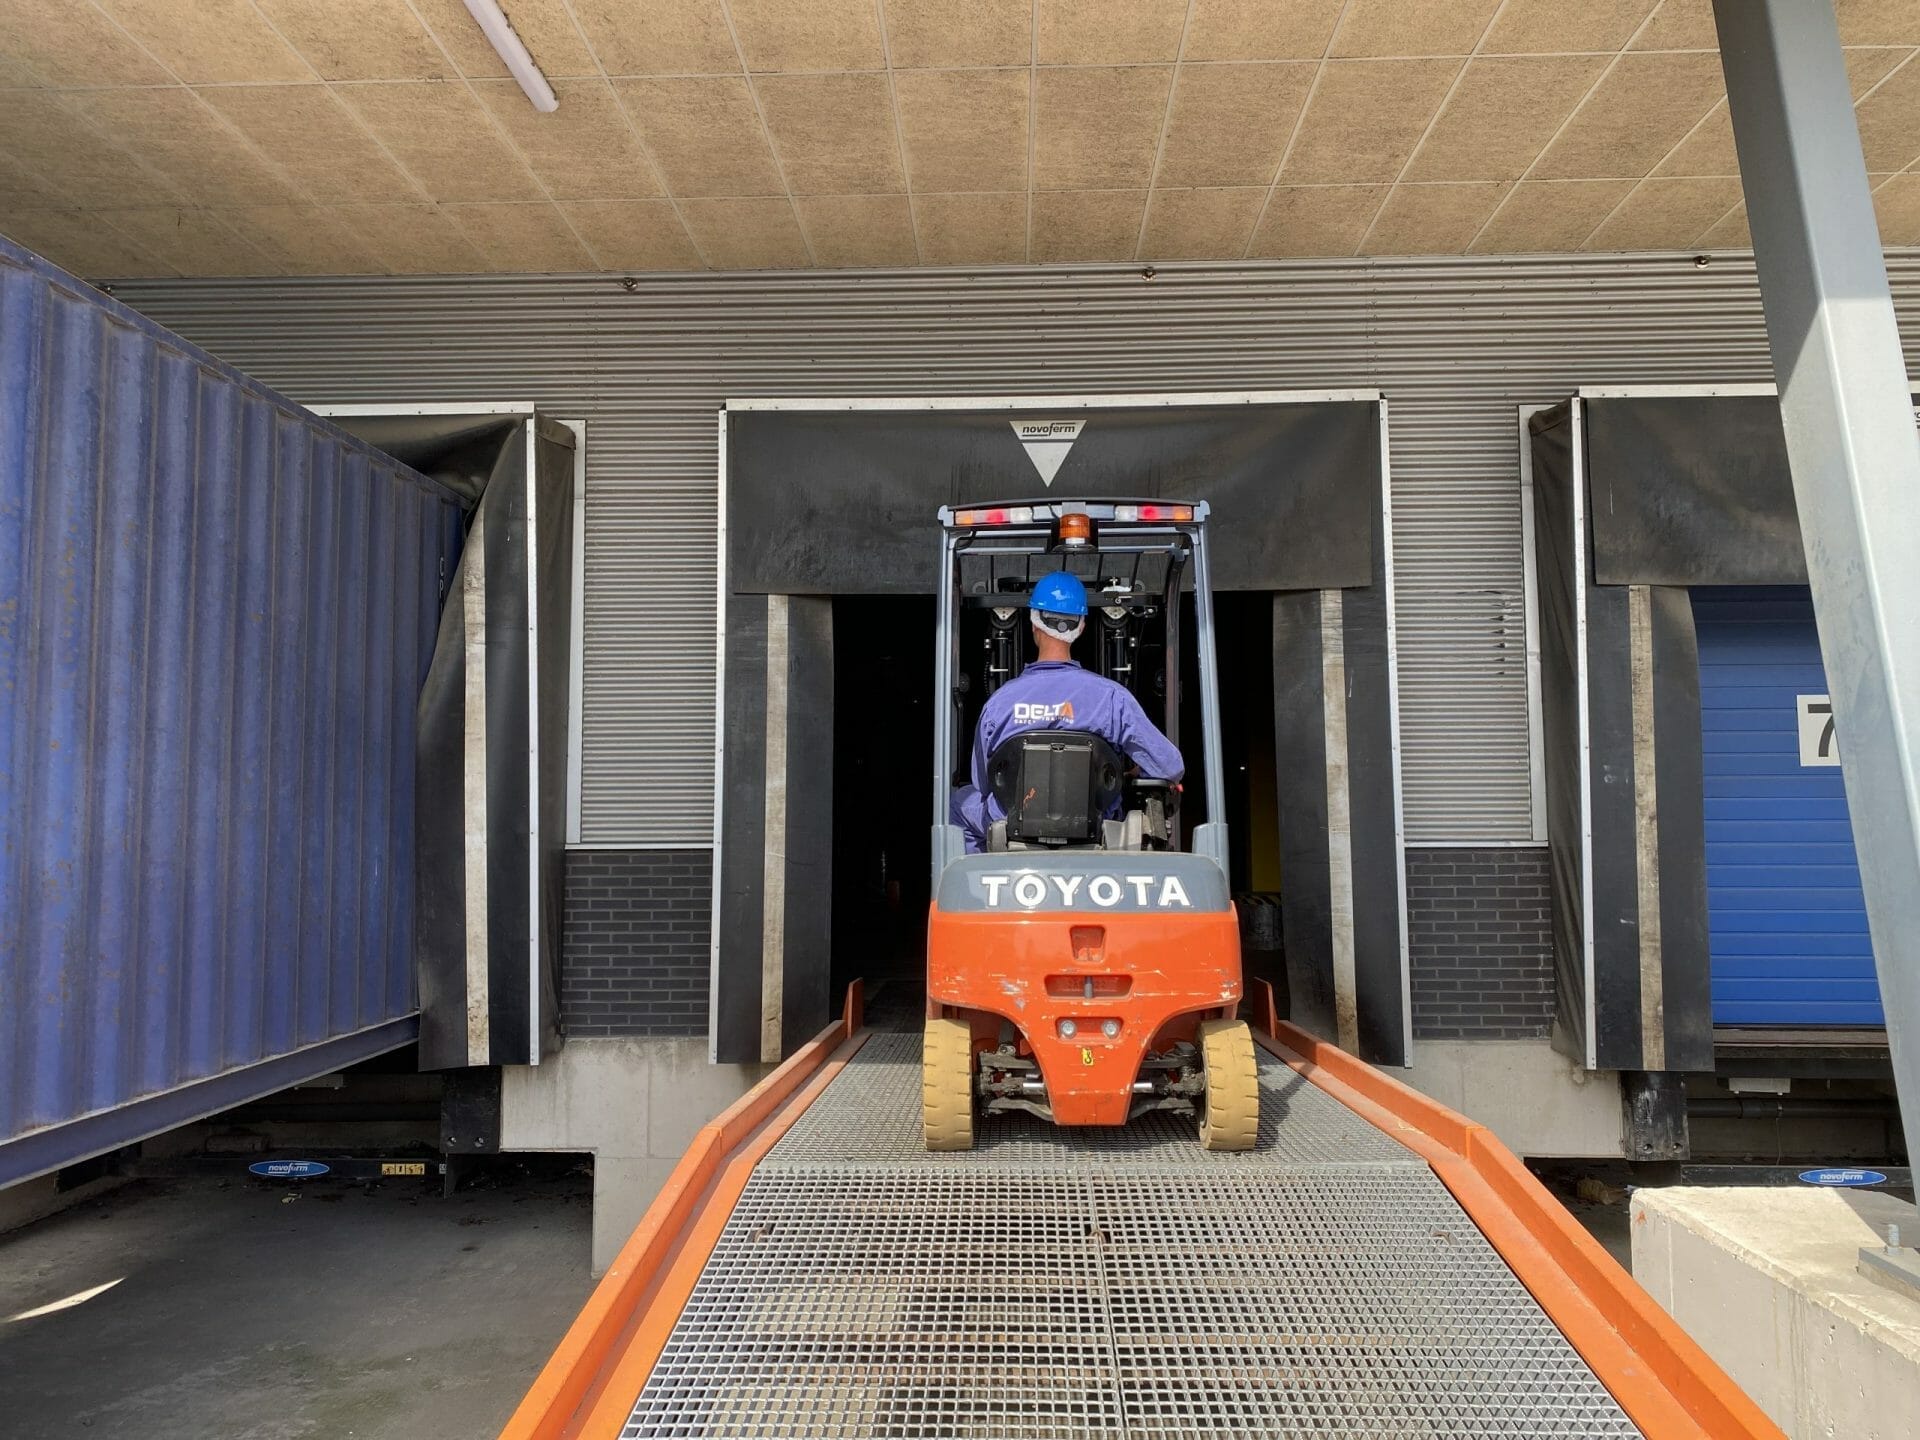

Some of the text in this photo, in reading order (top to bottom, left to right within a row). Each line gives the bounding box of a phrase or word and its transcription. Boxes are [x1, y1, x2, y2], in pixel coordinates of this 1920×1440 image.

[1022, 422, 1076, 437] novoferm
[1014, 701, 1074, 719] DELTA
[1808, 704, 1835, 757] 7
[982, 874, 1190, 906] TOYOTA
[1820, 1171, 1865, 1183] novoferm
